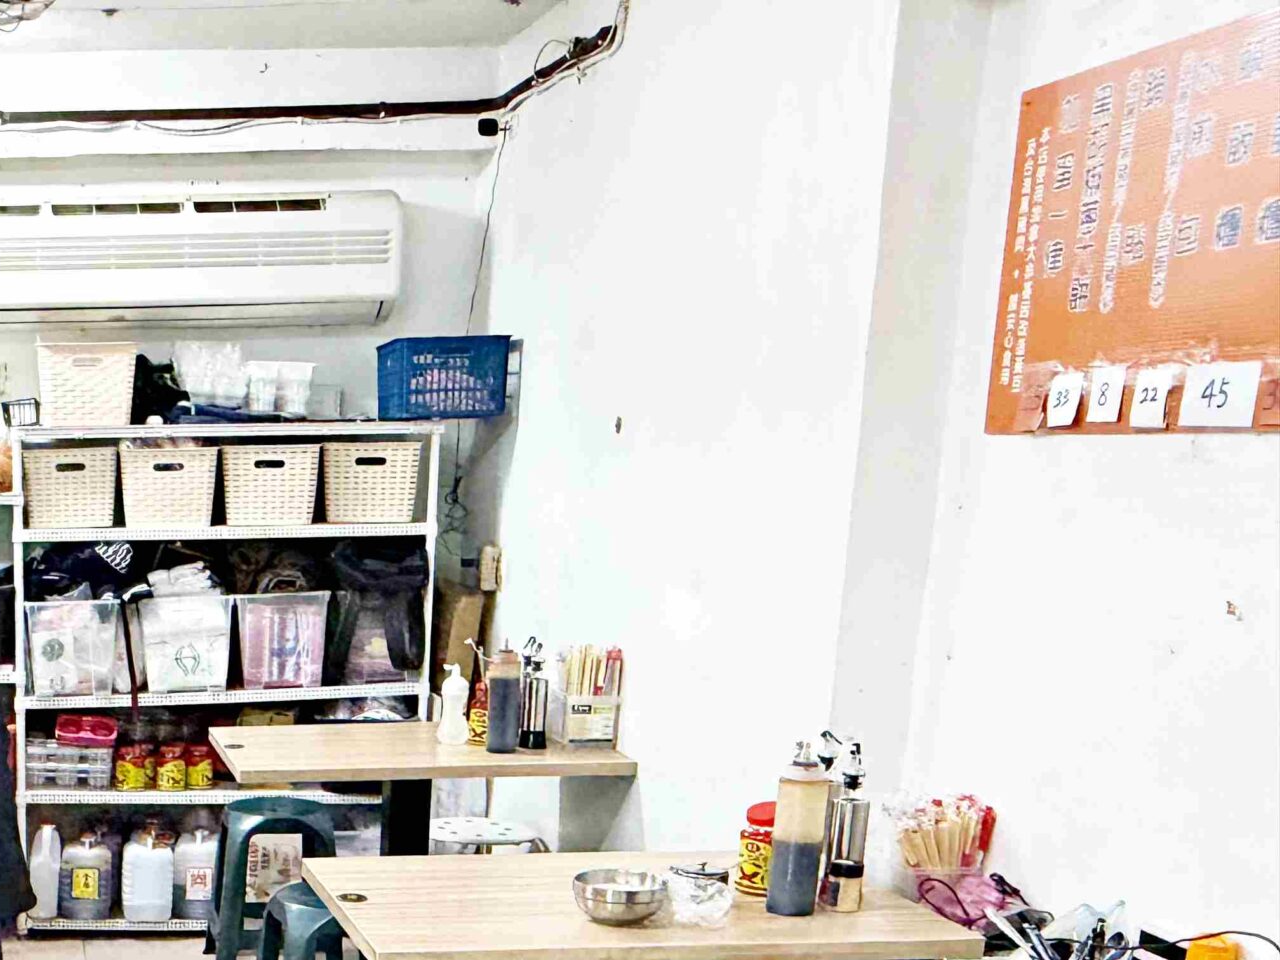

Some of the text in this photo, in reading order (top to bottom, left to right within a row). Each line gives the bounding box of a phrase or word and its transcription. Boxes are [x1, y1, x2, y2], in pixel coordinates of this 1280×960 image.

[1097, 382, 1110, 407] 8
[1139, 387, 1159, 404] 22
[1200, 377, 1231, 408] 45
